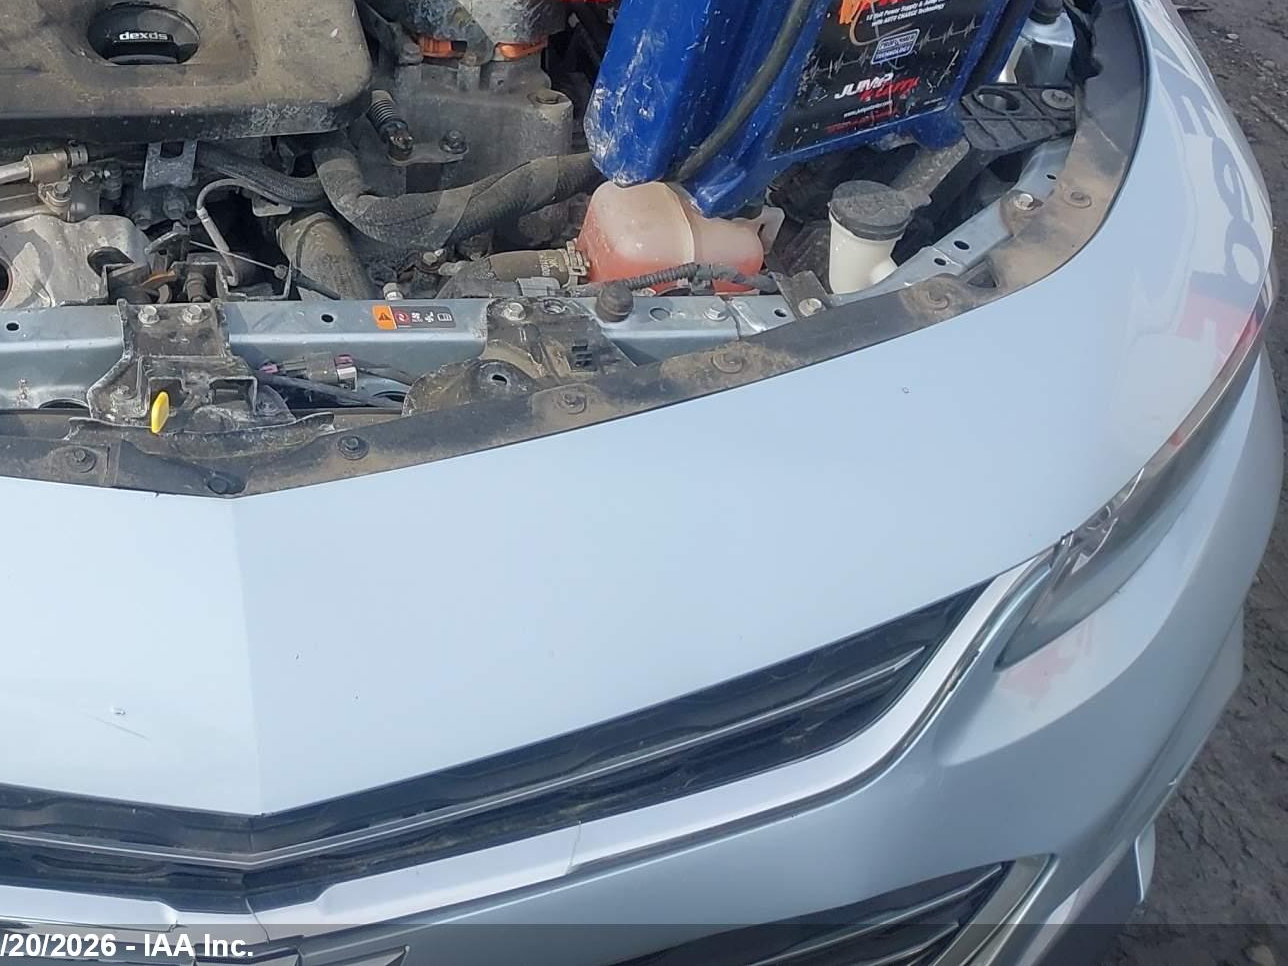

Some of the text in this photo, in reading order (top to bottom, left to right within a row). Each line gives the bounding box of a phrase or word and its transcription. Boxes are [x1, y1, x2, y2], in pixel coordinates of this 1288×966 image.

[884, 8, 900, 16] Power
[900, 3, 918, 13] Supply
[918, 0, 924, 8] &
[918, 3, 945, 15] Technology
[834, 72, 894, 99] JUMP
